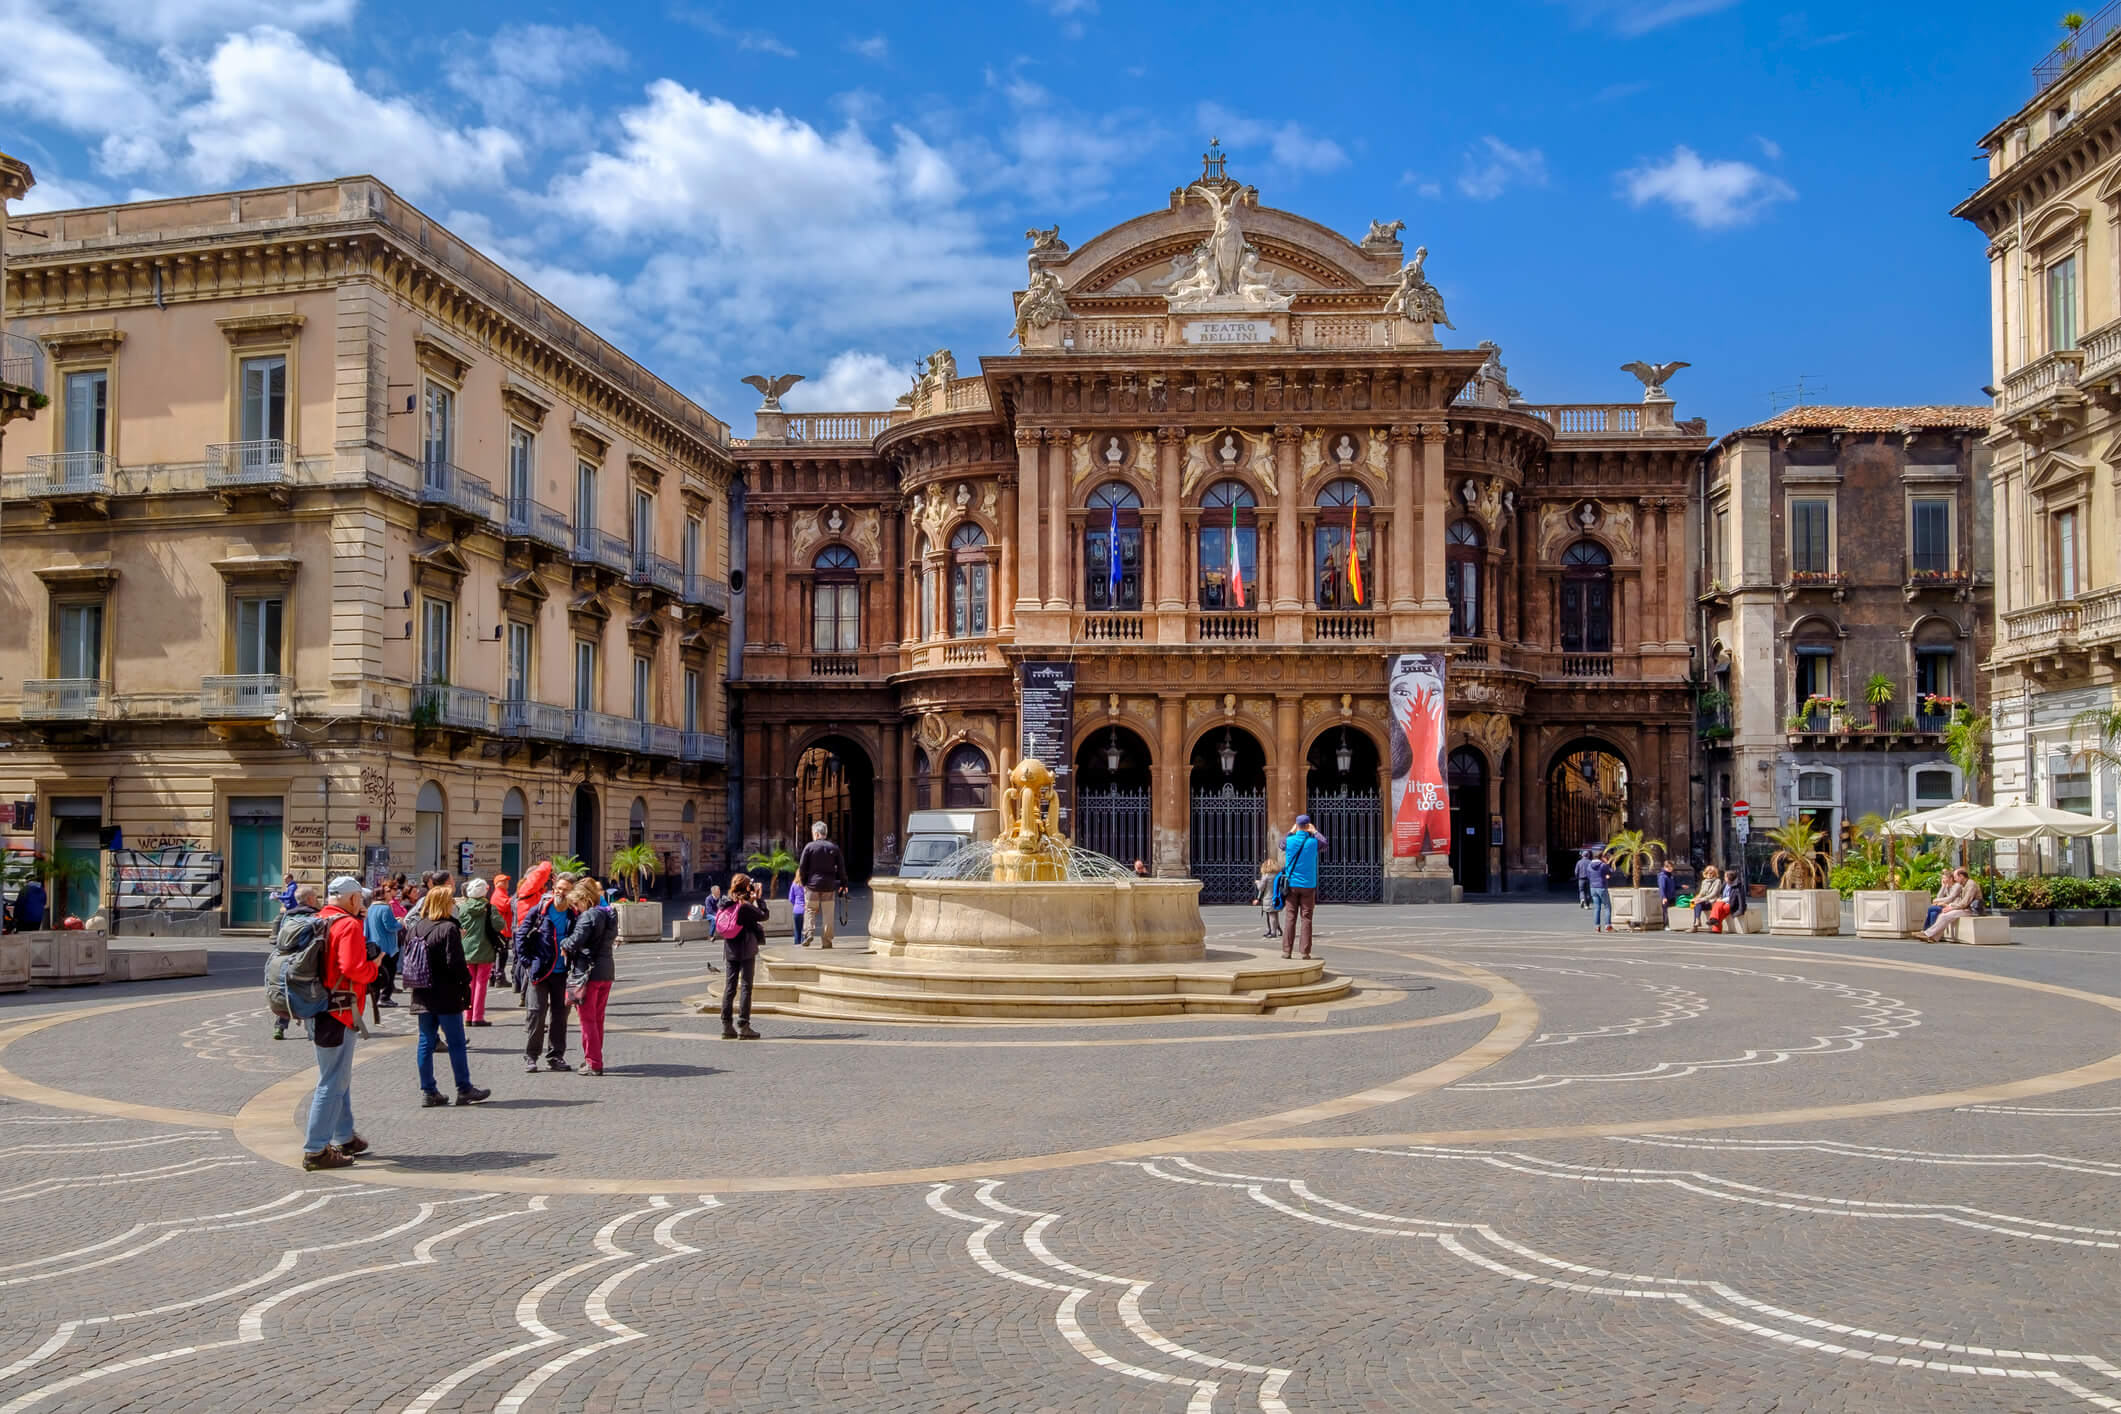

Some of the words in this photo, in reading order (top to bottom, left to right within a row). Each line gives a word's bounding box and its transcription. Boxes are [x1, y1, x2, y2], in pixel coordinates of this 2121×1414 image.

[1202, 324, 1256, 332] TEATRO
[1200, 332, 1257, 342] BELLINI
[1408, 780, 1415, 793] il
[1422, 791, 1437, 801] va
[1417, 799, 1445, 811] tore
